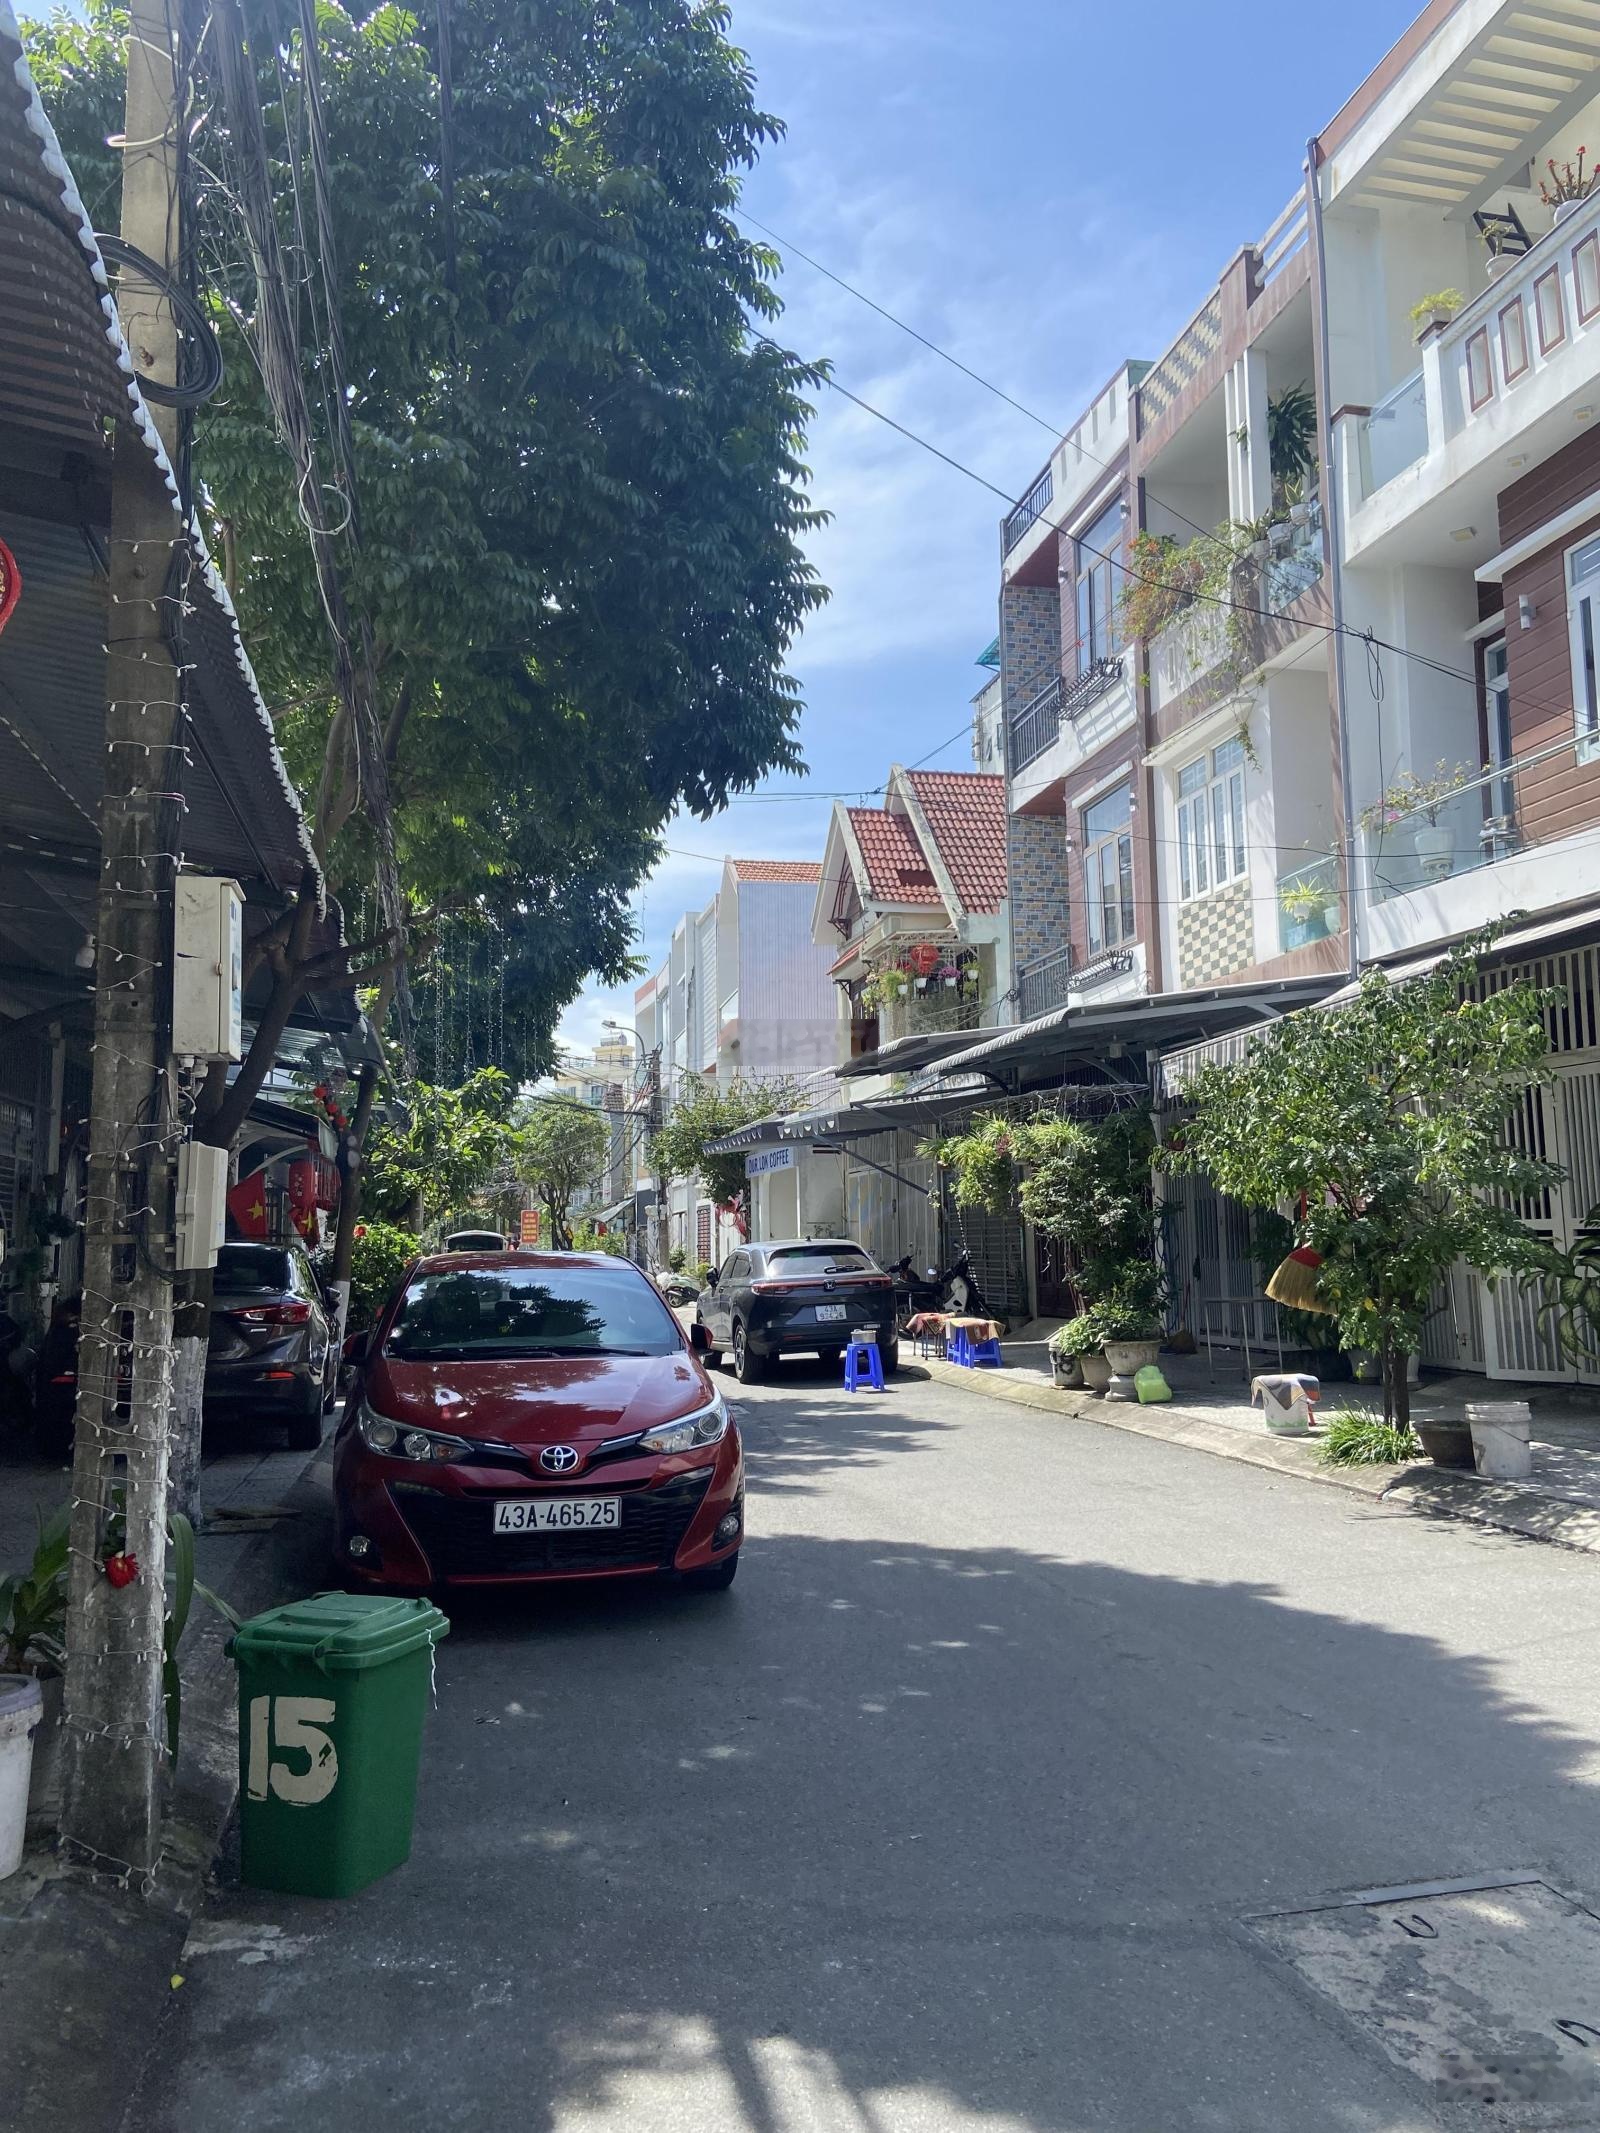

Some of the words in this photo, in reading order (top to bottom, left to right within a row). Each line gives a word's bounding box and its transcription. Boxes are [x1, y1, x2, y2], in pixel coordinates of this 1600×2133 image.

[769, 1148, 789, 1168] COFFEE
[825, 1305, 838, 1313] 43A
[499, 1501, 616, 1529] 43A-465.25
[247, 1695, 339, 1807] 15
